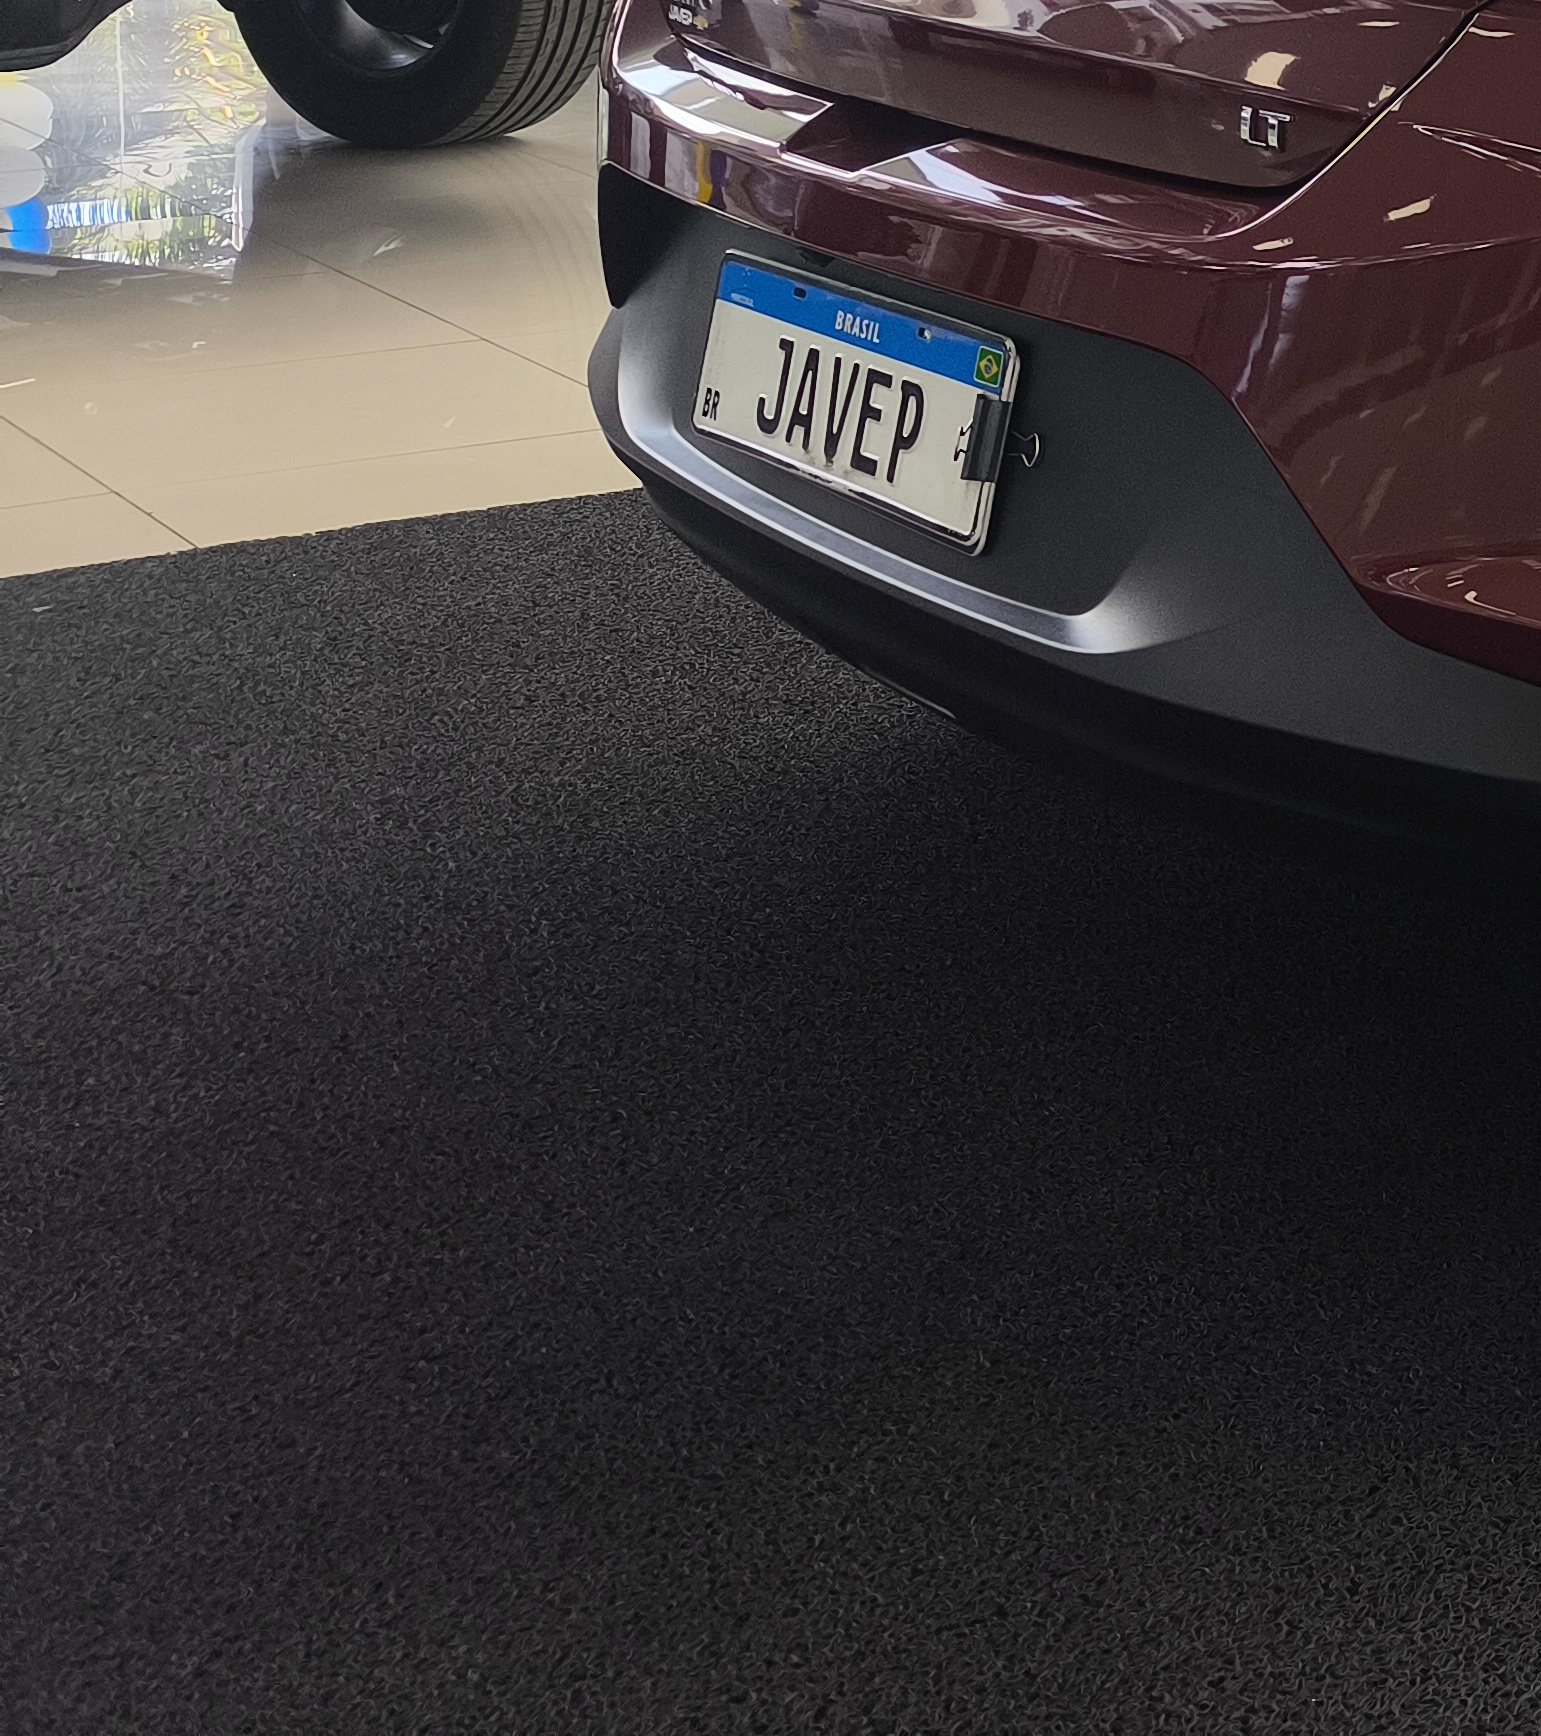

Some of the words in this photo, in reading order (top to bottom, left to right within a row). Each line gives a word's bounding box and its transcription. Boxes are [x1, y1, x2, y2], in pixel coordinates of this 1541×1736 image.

[1240, 105, 1291, 150] LT
[834, 309, 881, 345] BRASIL
[701, 387, 721, 422] BR
[756, 335, 925, 484] JAVEP
